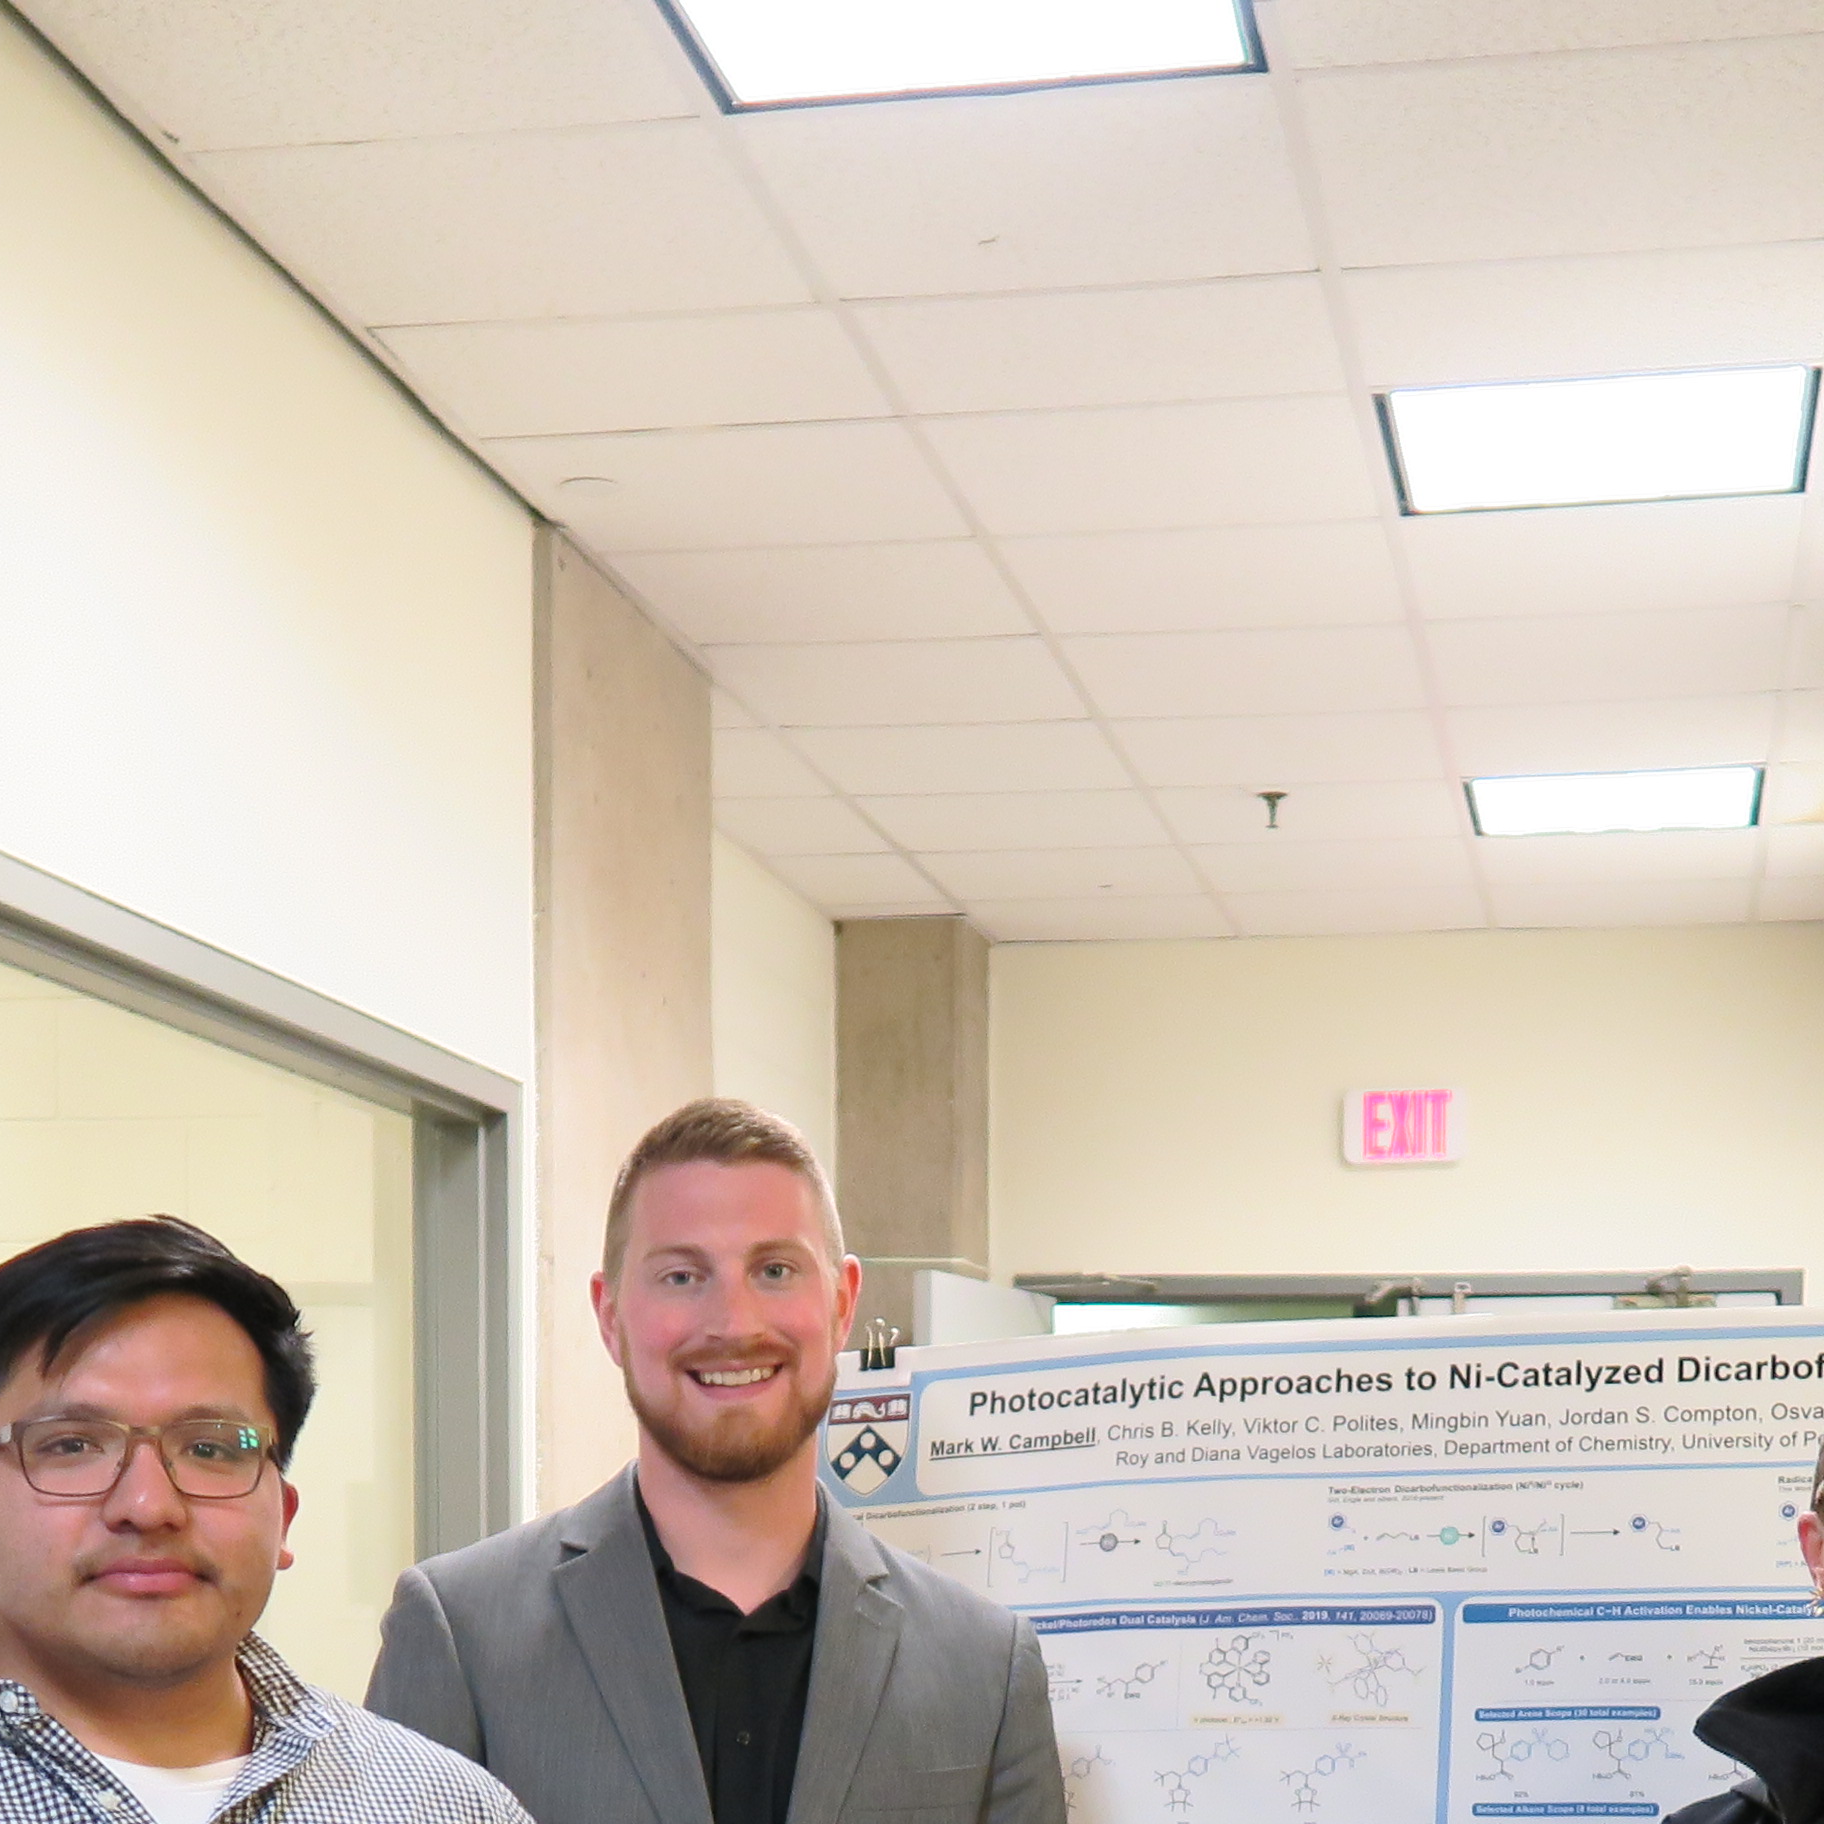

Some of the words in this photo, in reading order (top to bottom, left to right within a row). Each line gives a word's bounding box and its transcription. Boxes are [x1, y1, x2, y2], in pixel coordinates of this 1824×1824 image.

[1363, 1089, 1452, 1160] EXIT
[970, 1373, 1184, 1416] Photocatalytic
[1193, 1366, 1392, 1403] Approaches
[1405, 1366, 1437, 1391] to
[1449, 1357, 1664, 1392] Ni-Catalyzed
[930, 1437, 973, 1460] Mark
[981, 1435, 1002, 1454] W.
[1009, 1427, 1099, 1453] Campbell,
[1108, 1421, 1154, 1441] Chris
[1161, 1420, 1179, 1438] B.
[1186, 1415, 1236, 1438] Kelly,
[1243, 1413, 1298, 1435] Viktor
[1305, 1414, 1326, 1434] C.
[1333, 1412, 1404, 1433] Polites,
[1412, 1411, 1489, 1434] Mingbin
[1495, 1410, 1552, 1430] Yuan,
[1560, 1407, 1628, 1427] Jordan
[1636, 1406, 1656, 1424] S.
[1664, 1403, 1764, 1425] Compton,
[1116, 1450, 1147, 1471] Roy
[1154, 1448, 1185, 1465] and
[1191, 1445, 1241, 1463] Diana
[1246, 1443, 1316, 1465] Vagelos
[1323, 1437, 1437, 1461] Laboratories,
[1444, 1437, 1550, 1460] Department
[1555, 1436, 1574, 1453] of
[1579, 1434, 1675, 1456] Chemistry,
[1682, 1431, 1774, 1453] University
[1779, 1430, 1799, 1447] of
[1328, 1484, 1391, 1495] Two-Electron
[1119, 1614, 1144, 1627] Dual
[1148, 1612, 1196, 1628] Catalysis
[1215, 1613, 1235, 1624] Am.
[1239, 1611, 1269, 1624] Chem.
[1302, 1610, 1331, 1623] 2019,
[1336, 1610, 1357, 1622] 141,
[1508, 1606, 1594, 1619] Photochemical
[1623, 1605, 1682, 1617] Activation
[1686, 1604, 1734, 1616] Enables
